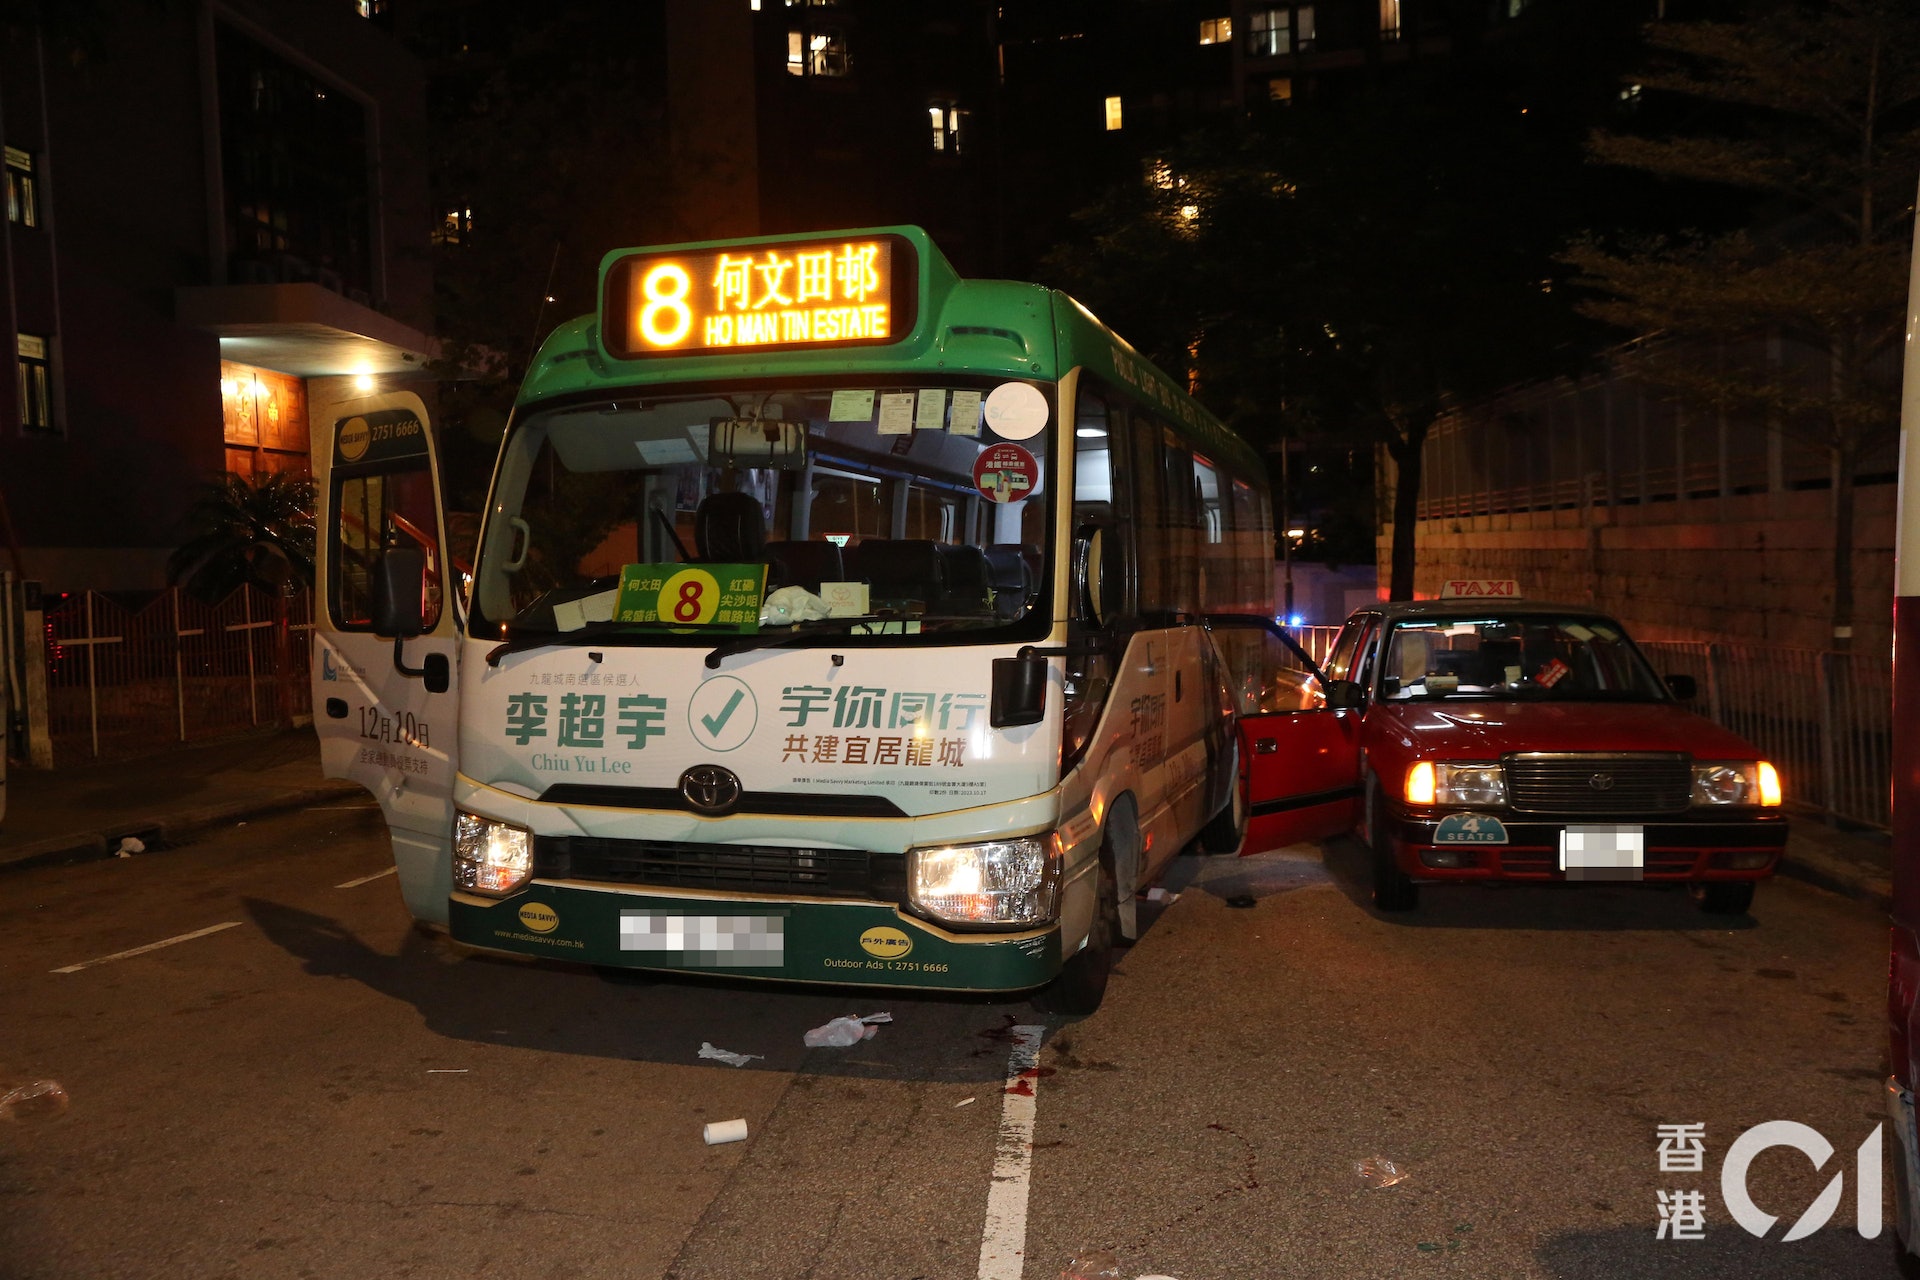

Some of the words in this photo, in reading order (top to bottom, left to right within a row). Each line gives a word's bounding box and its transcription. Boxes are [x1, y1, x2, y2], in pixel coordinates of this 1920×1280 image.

[713, 243, 879, 311] 何文田邨
[640, 262, 692, 347] 8
[706, 315, 734, 346] HO
[737, 312, 778, 345] MAN
[782, 310, 810, 342] TIN
[814, 305, 887, 340] ESTATE
[372, 424, 393, 441] 2751
[395, 419, 419, 438] 6666
[628, 578, 662, 592] 何文田
[729, 578, 755, 592] 紅磡
[1450, 581, 1514, 595] TAXI
[674, 580, 704, 623] 8
[720, 594, 758, 608] 尖沙咀
[529, 673, 640, 687] 九龍城南選區候選人
[779, 685, 986, 731] 宇你同行
[359, 706, 430, 749] 12月10日
[505, 692, 667, 751] 李超宇
[781, 734, 967, 768] 共建宜居龍城
[532, 753, 569, 771] Chiu
[574, 756, 594, 773] Yu
[601, 756, 631, 774] Lee
[1461, 818, 1480, 833] 4
[1447, 832, 1495, 841] SEATS
[519, 911, 537, 920] MEDIA
[538, 913, 556, 922] SAVVY
[494, 929, 585, 949] www.mediasavvy.com.hk
[862, 937, 909, 947] 戶外廣告
[824, 958, 863, 968] Outdoor
[866, 960, 884, 970] Ads
[896, 962, 920, 971] 2751
[923, 963, 949, 973] 6666
